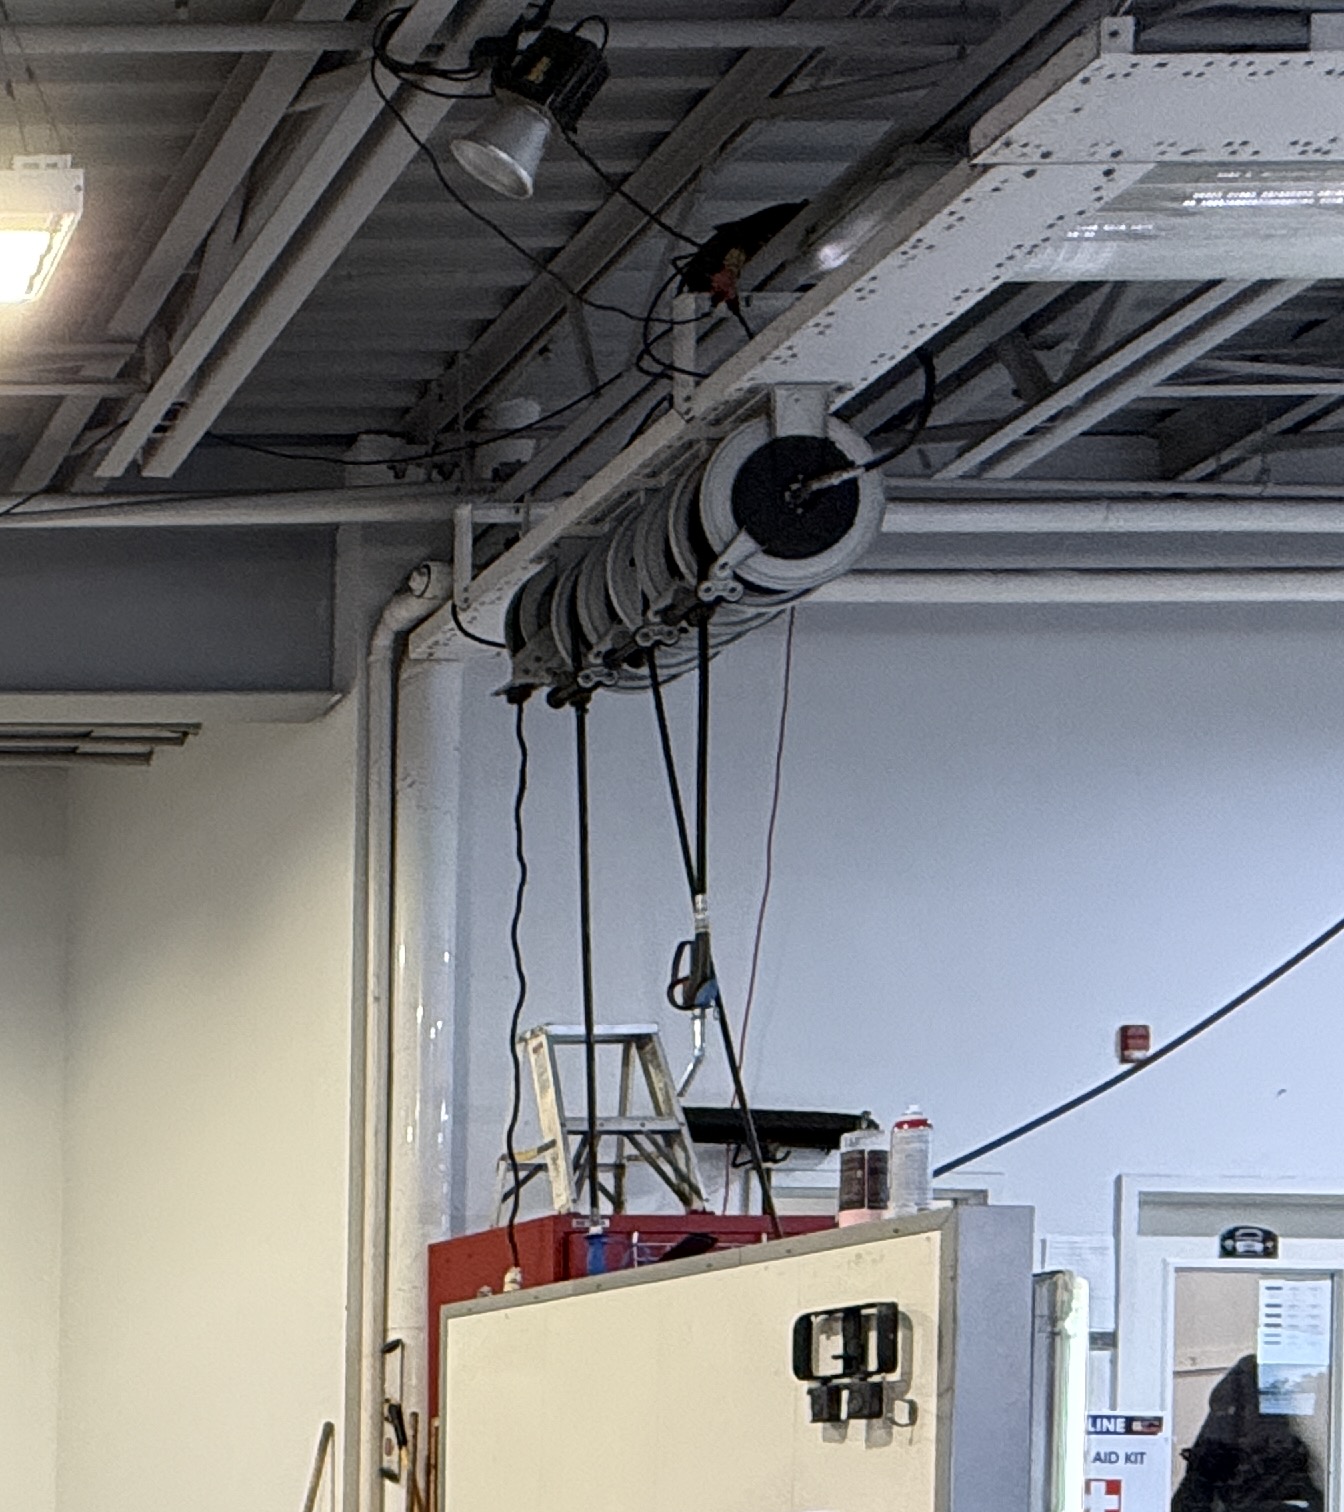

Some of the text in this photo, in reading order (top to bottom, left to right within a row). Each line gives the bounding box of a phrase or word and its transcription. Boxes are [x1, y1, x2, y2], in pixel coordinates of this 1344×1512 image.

[1087, 1417, 1126, 1433] LINE
[1091, 1450, 1147, 1465] AID KIT
